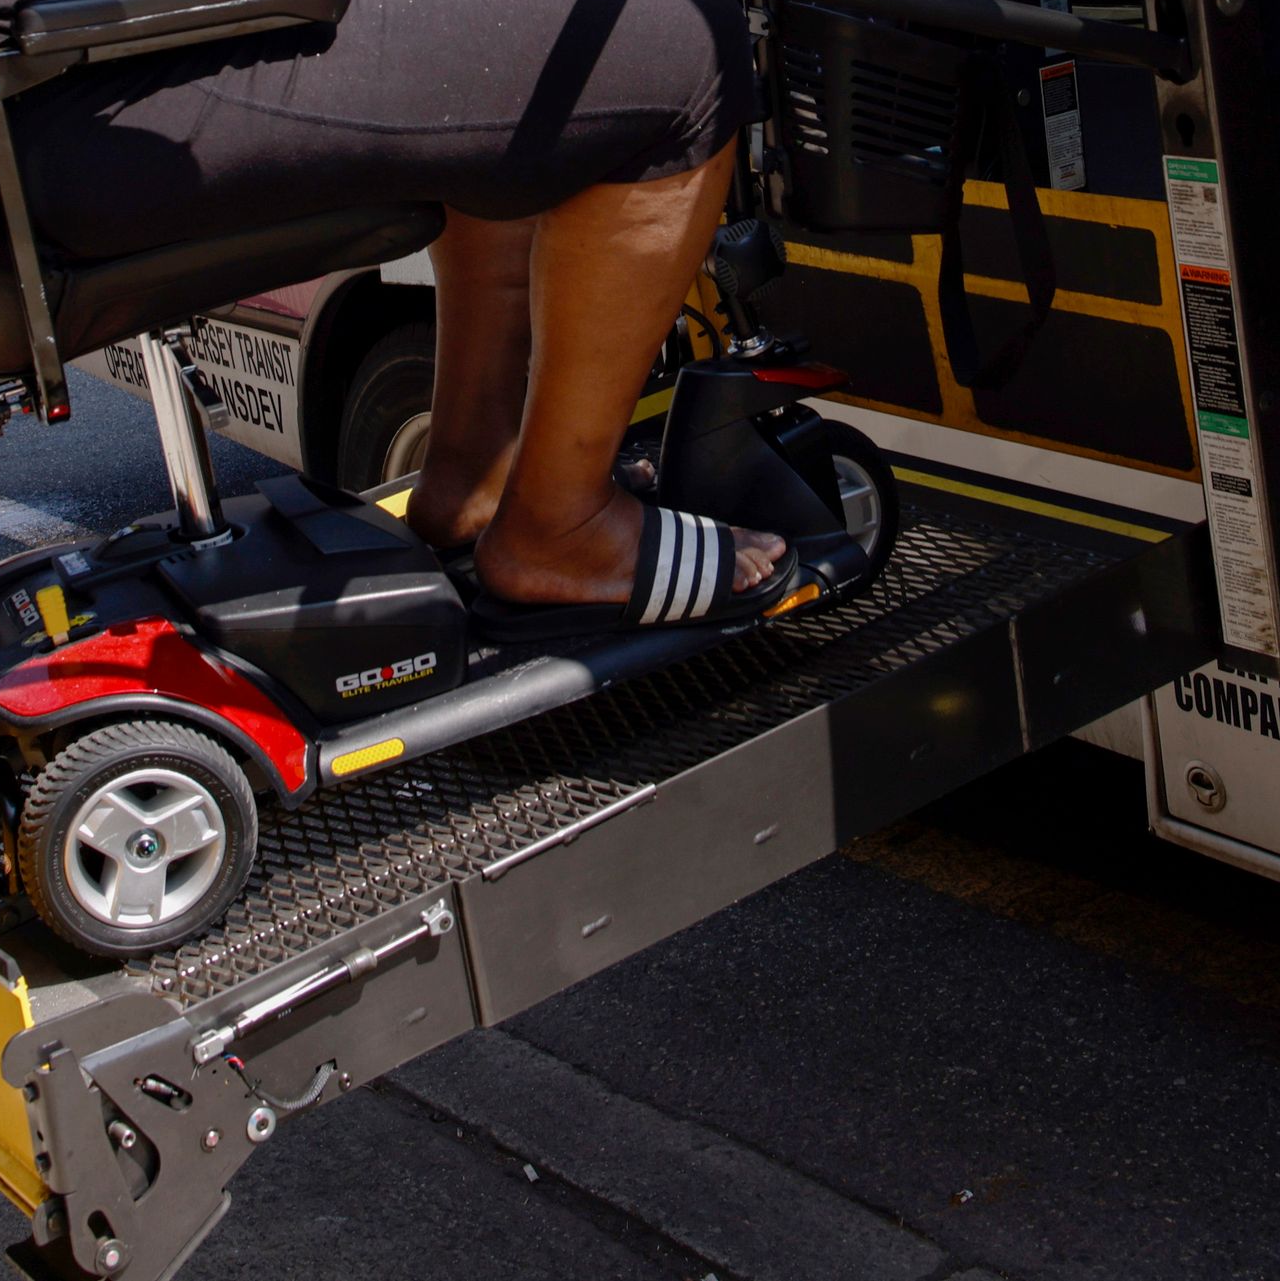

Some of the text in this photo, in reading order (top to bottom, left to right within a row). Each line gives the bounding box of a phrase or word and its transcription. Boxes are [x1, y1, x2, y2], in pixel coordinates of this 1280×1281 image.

[235, 330, 296, 387] TRANSIT
[342, 668, 434, 699] ELITE TRAVELLER
